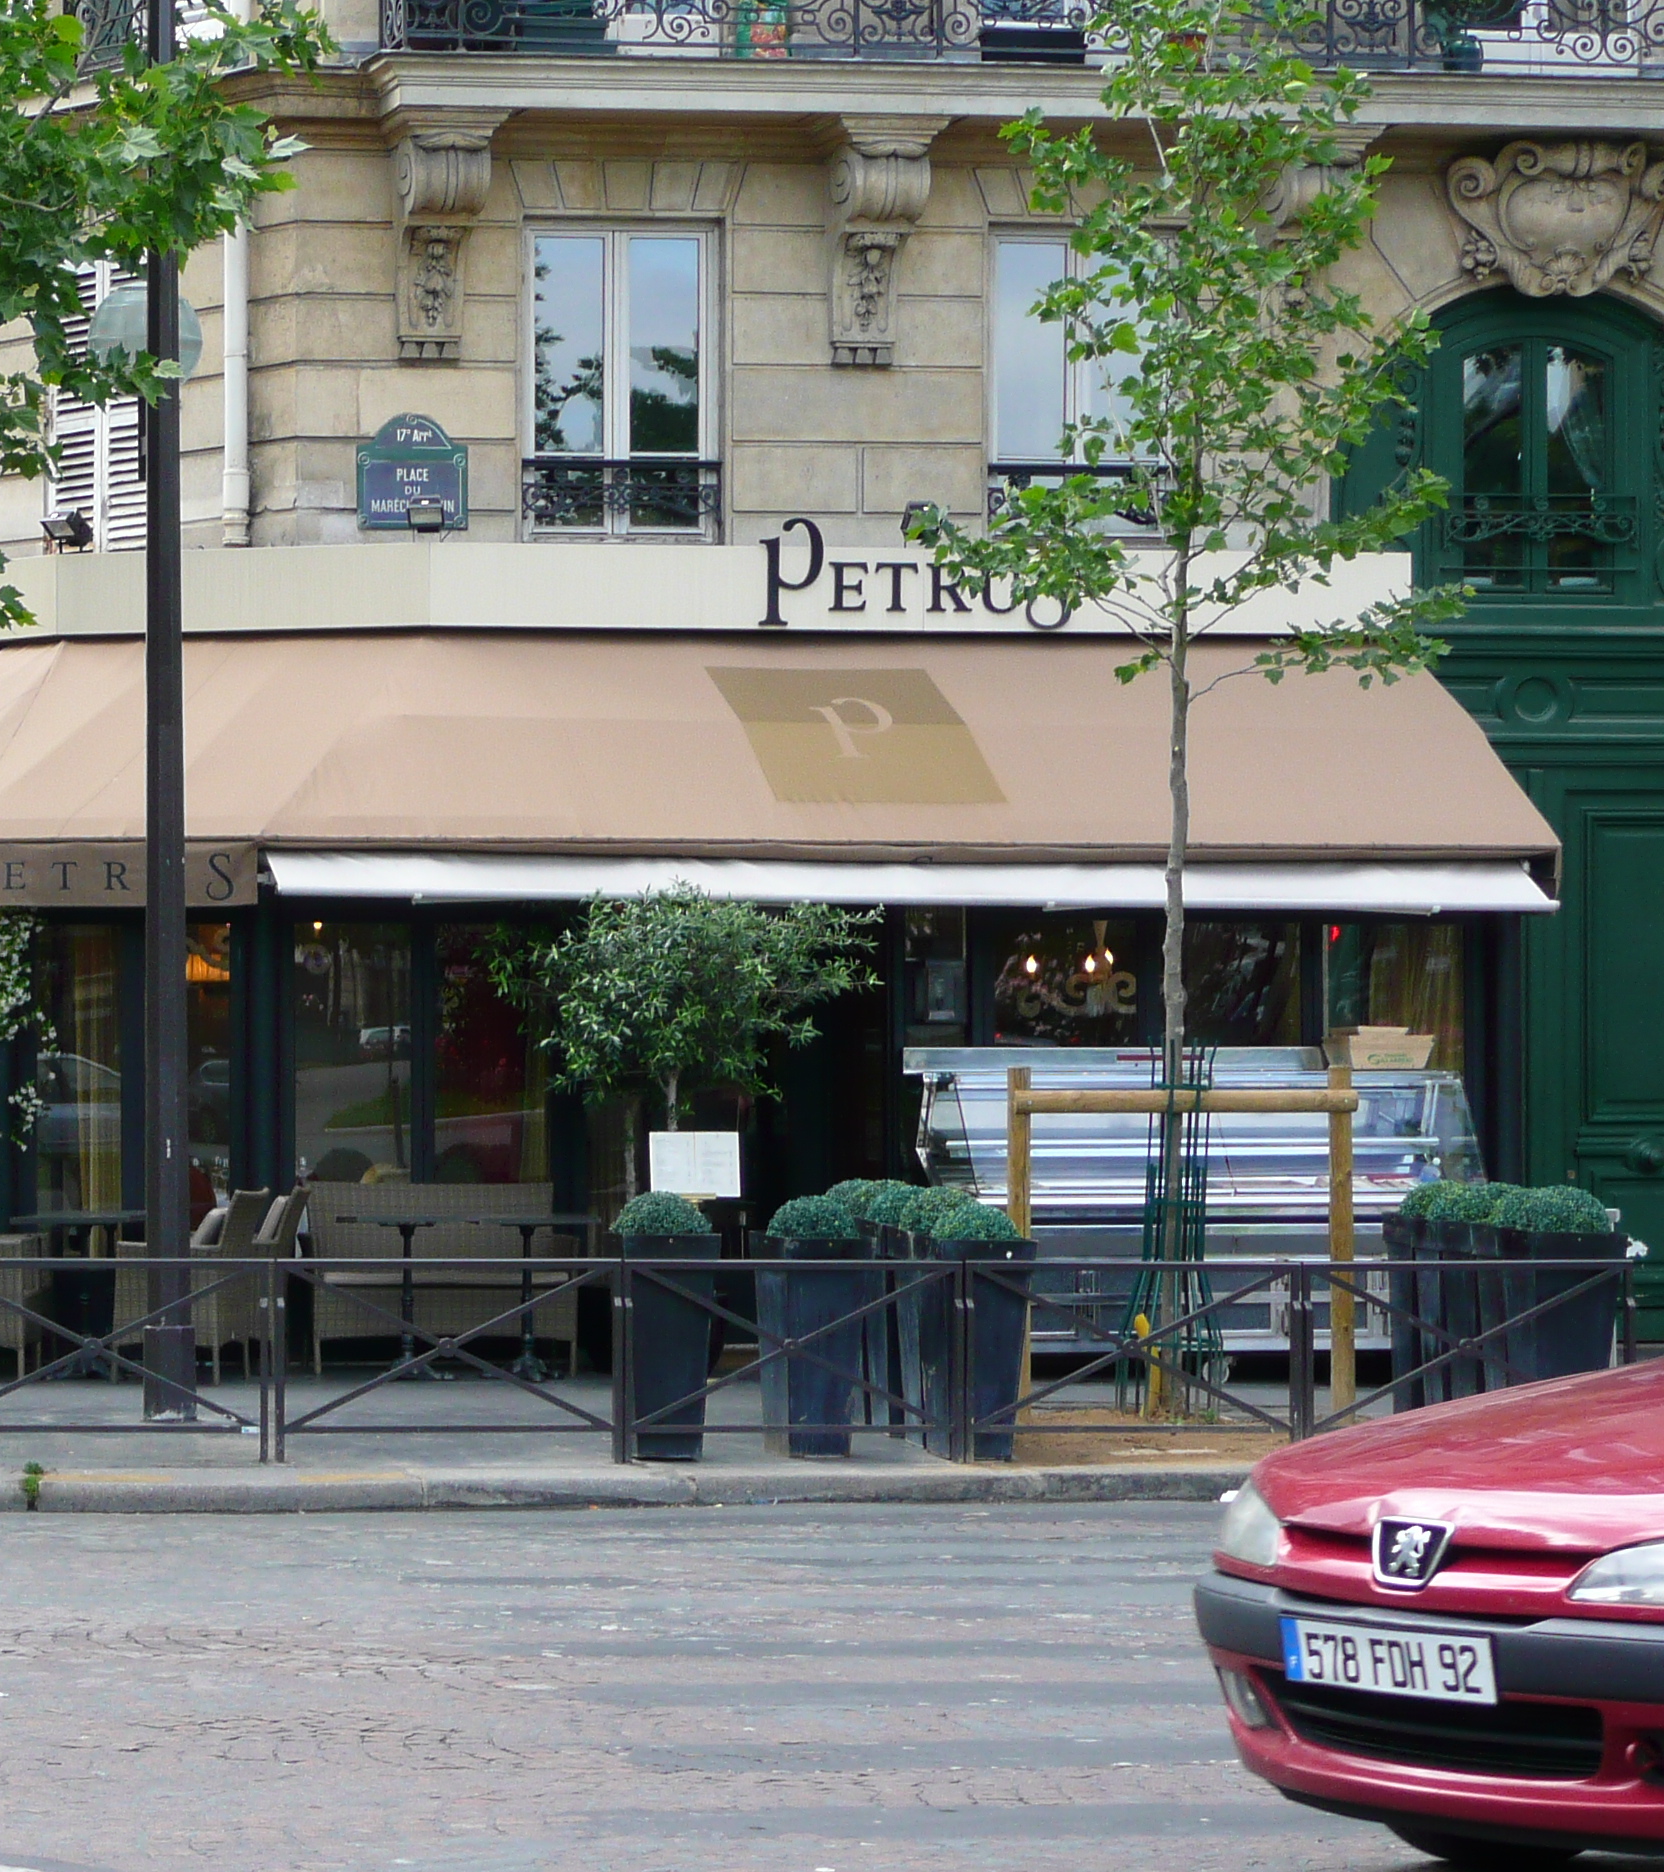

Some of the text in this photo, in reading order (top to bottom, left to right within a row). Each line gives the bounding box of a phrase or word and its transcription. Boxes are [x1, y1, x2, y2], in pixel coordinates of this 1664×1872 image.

[396, 468, 429, 482] PLACE
[404, 485, 421, 495] DU
[758, 517, 1072, 630] PETRU
[809, 697, 893, 759] P
[1305, 1632, 1482, 1695] 578 FDH 92
